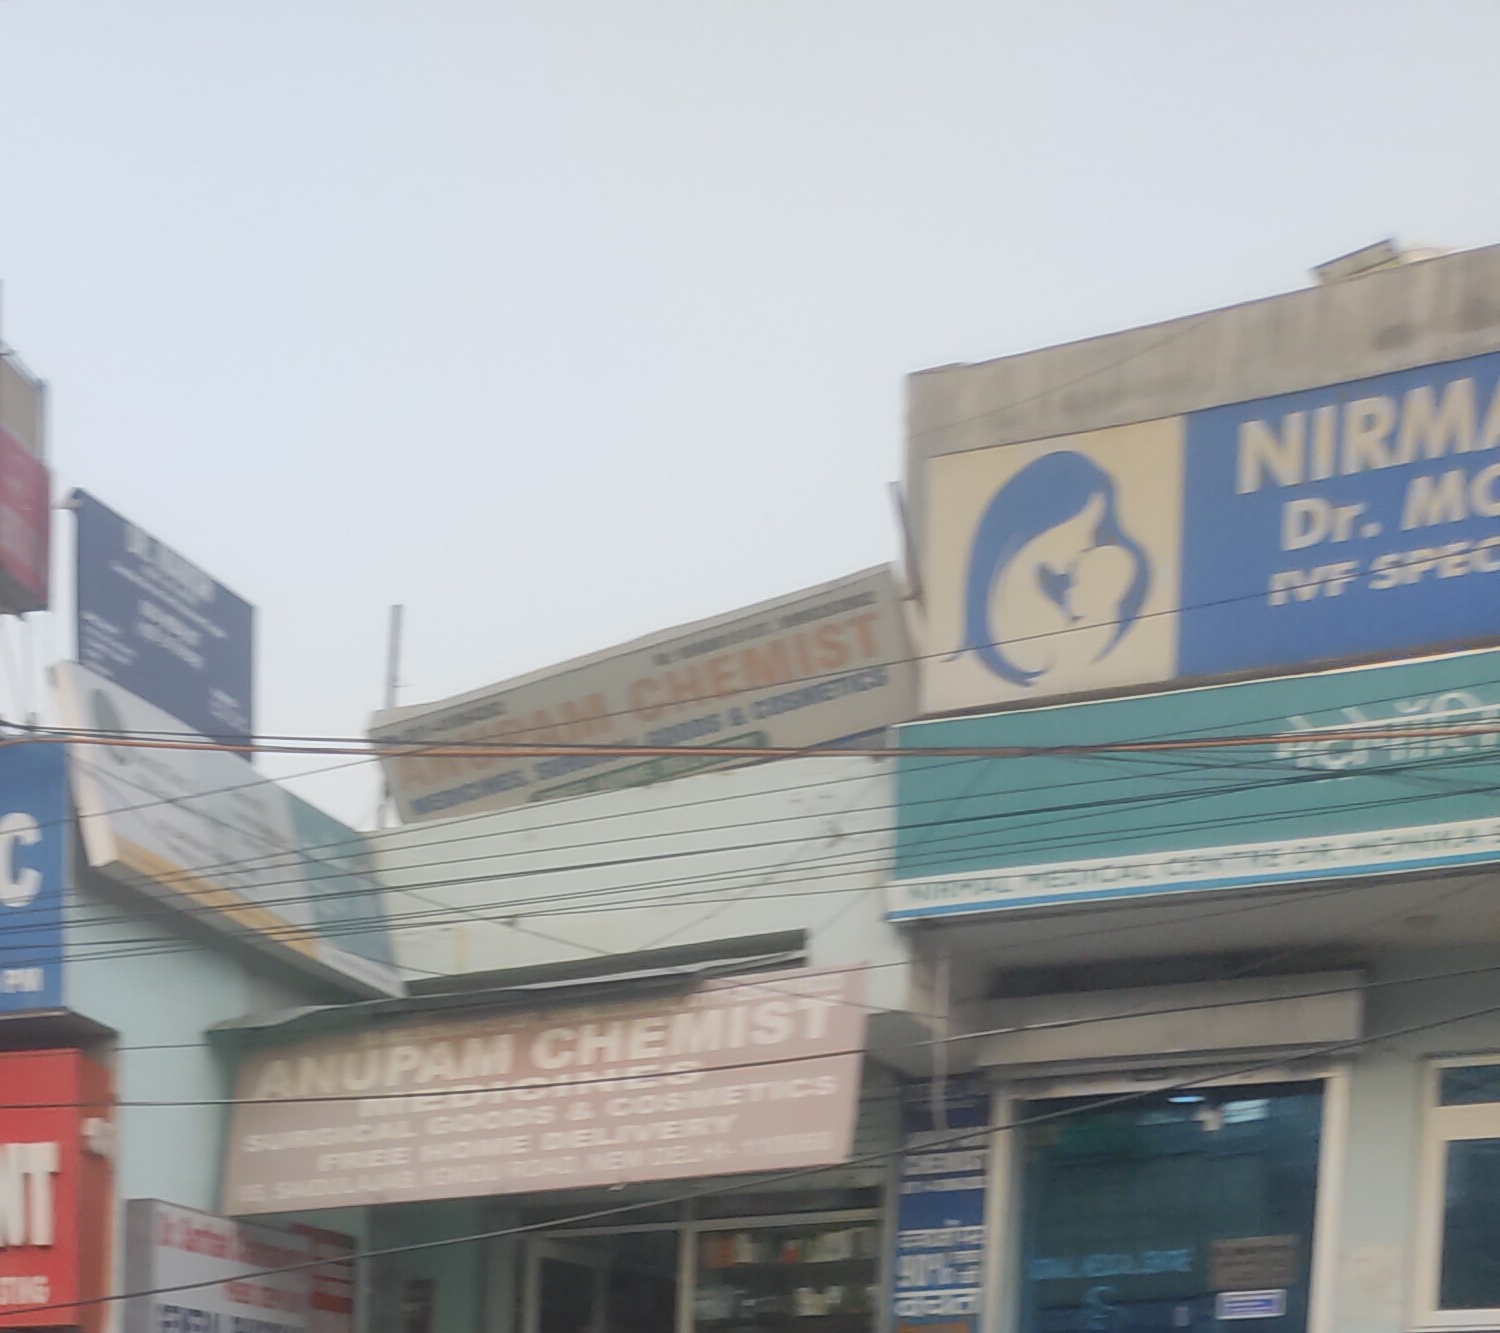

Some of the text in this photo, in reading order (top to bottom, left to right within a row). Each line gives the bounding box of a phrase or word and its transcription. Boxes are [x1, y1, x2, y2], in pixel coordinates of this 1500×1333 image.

[1281, 496, 1383, 552] Dr.
[627, 612, 882, 722] CHEMIST
[254, 997, 838, 1098] ANUPAM CHEMIST
[603, 1074, 842, 1117] COSMETICS
[315, 1144, 414, 1173] FREE
